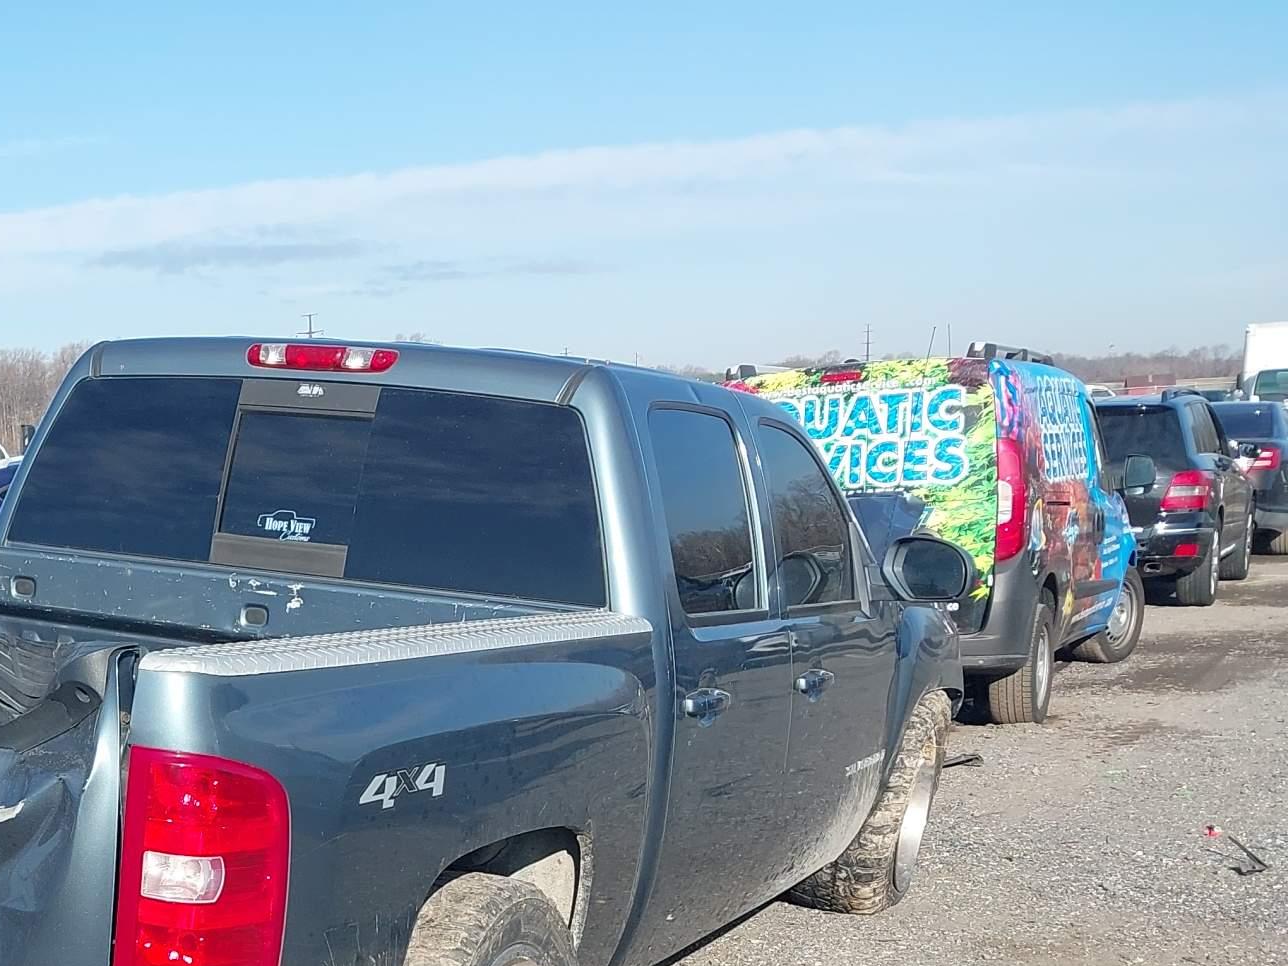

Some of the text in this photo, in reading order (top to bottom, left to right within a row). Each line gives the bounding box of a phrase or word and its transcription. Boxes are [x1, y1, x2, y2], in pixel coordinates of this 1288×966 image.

[771, 386, 965, 443] UATIC
[265, 517, 312, 534] HOPE VIEW
